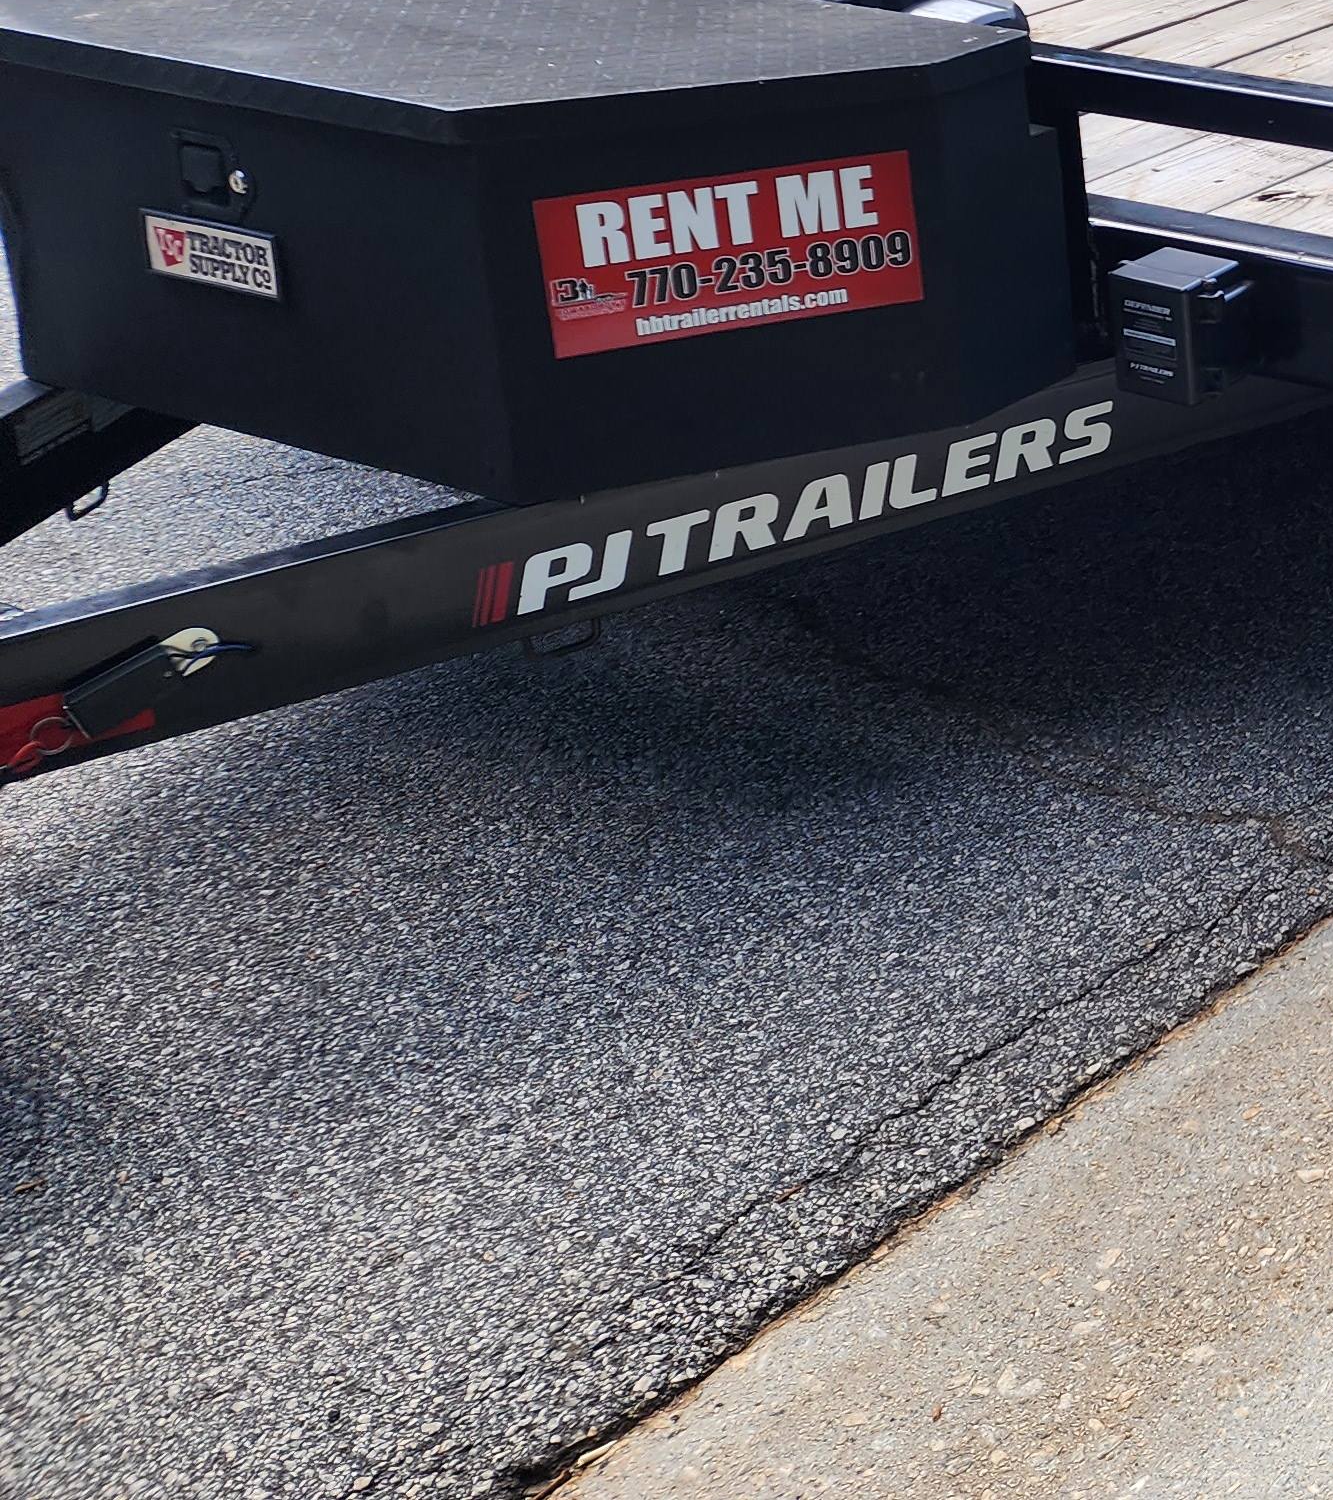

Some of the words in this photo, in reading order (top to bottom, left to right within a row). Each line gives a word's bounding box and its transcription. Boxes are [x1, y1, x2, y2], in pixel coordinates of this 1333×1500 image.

[186, 231, 269, 267] TRACTOR
[575, 180, 759, 268] RENT
[775, 165, 878, 239] ME
[189, 253, 250, 285] SUPPLY
[624, 230, 912, 308] 770-235-8909
[516, 529, 634, 616] PJ
[645, 400, 1114, 577] TRAILERS
